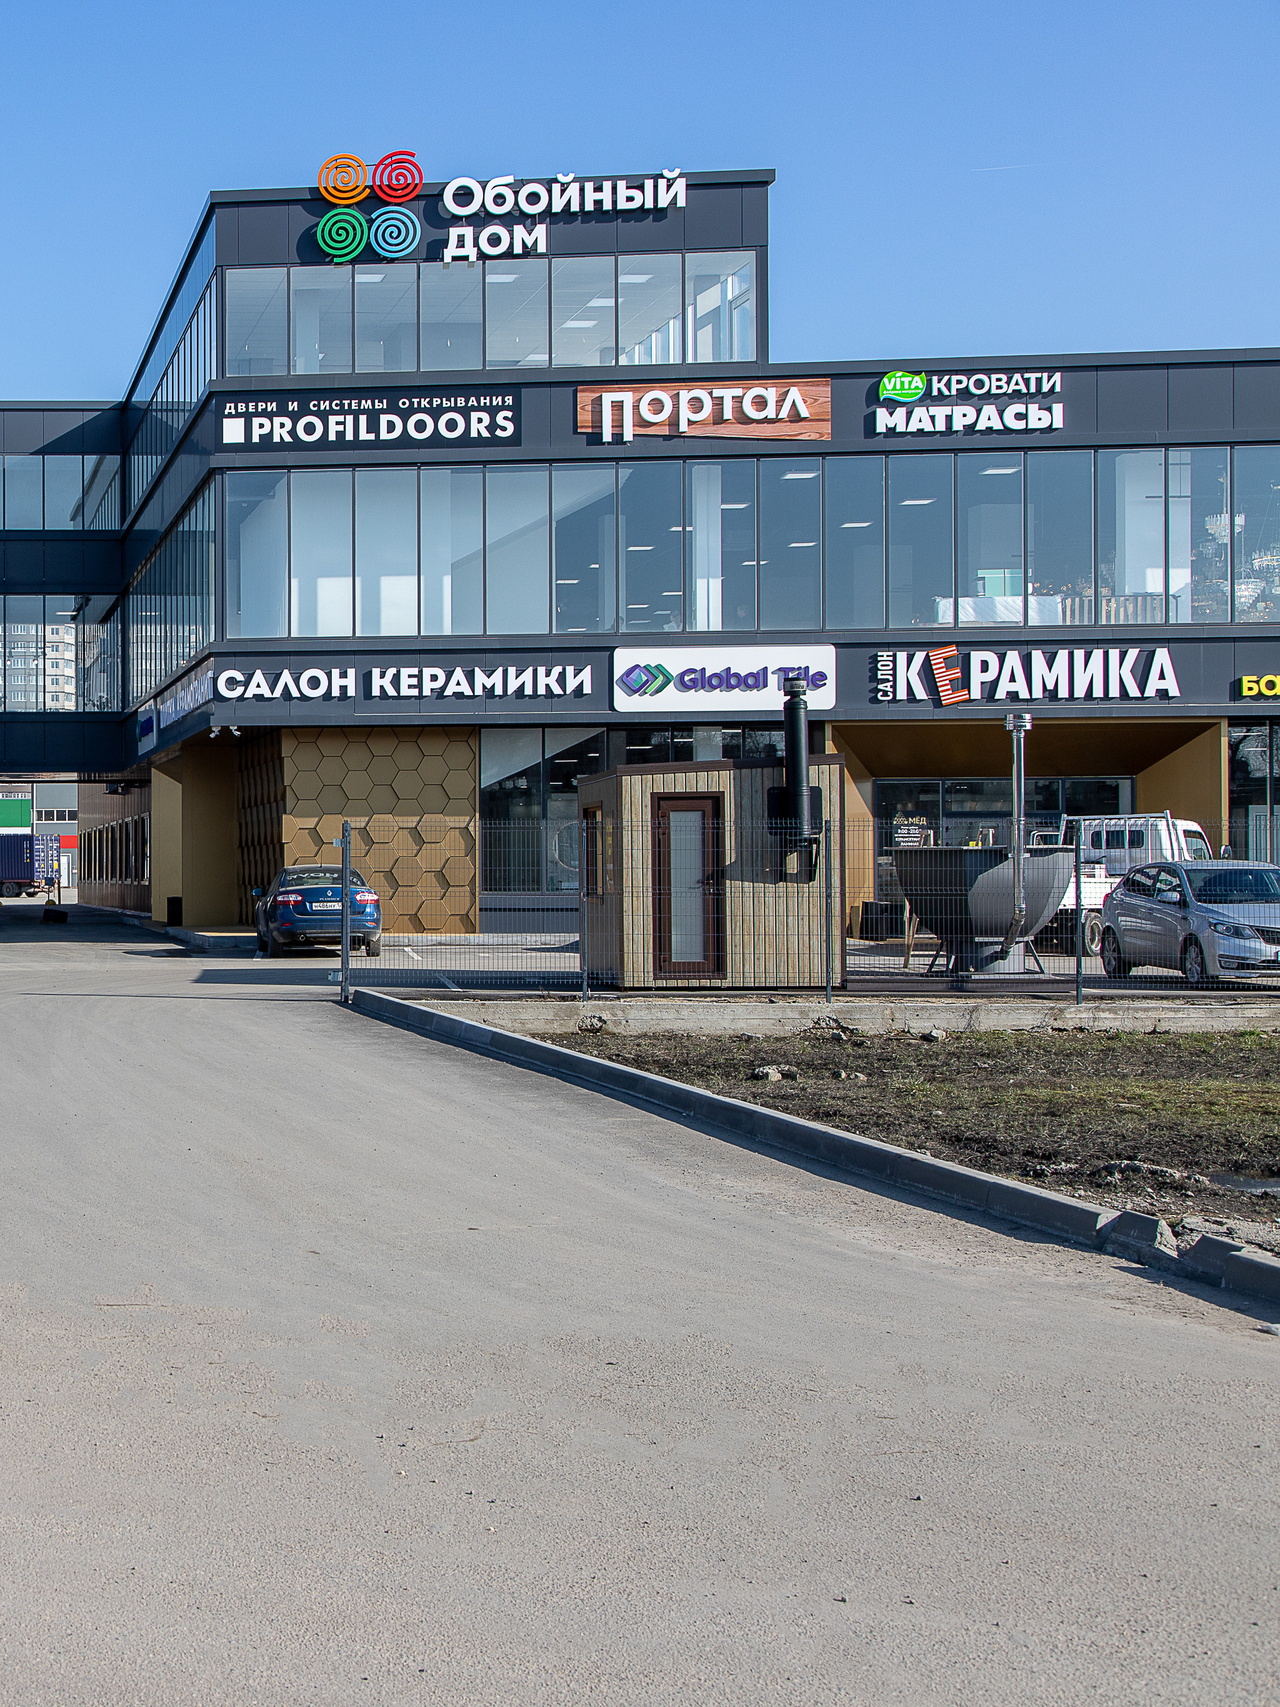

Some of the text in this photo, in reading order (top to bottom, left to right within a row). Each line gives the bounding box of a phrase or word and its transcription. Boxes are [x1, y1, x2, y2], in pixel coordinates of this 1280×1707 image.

[443, 168, 687, 217] Обойный
[932, 373, 1062, 396] КРОВАТИ
[224, 395, 514, 415] ДВЕРИ И СИСТЕМЫ ОТКРЫВАНИЯ
[601, 386, 810, 442] Портал
[875, 403, 1064, 433] МАТРАСЫ
[252, 411, 516, 444] PROFILDOORS
[216, 664, 592, 699] САЛОН КЕРАМИКИ
[679, 665, 828, 690] Global Tile
[877, 651, 894, 701] САЛОН
[895, 644, 1181, 706] КЕРАМИКА
